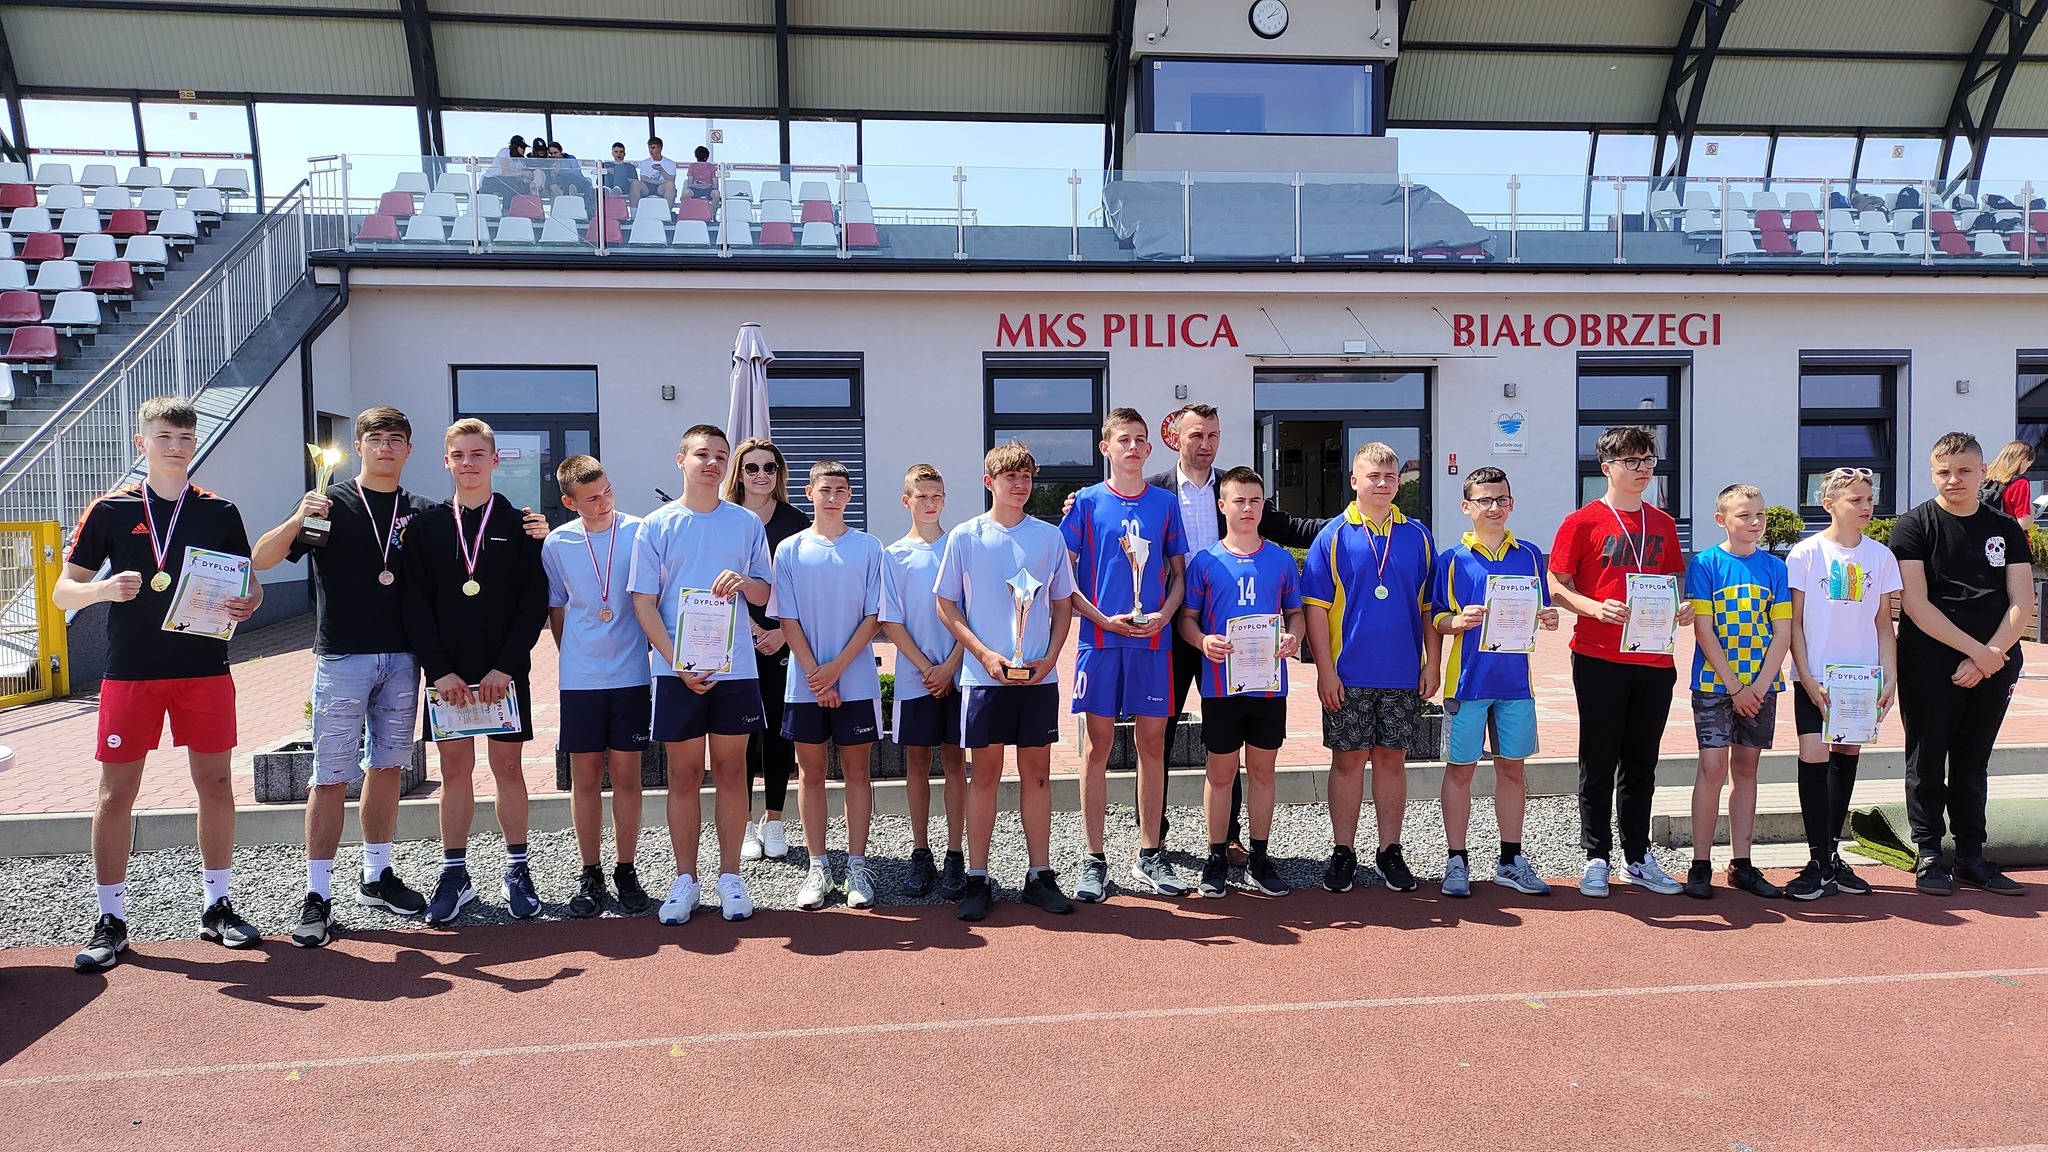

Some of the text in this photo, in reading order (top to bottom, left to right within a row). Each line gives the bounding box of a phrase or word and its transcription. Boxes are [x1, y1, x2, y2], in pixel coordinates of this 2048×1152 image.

[996, 313, 1239, 348] MKS PILICA
[1453, 313, 1721, 347] BIAŁOBRZEGI
[1601, 533, 1664, 568] NIKE
[201, 560, 236, 573] DYPLOM
[693, 598, 725, 607] DYPLOM
[1237, 576, 1256, 606] 14
[1238, 623, 1268, 631] DYPLOM
